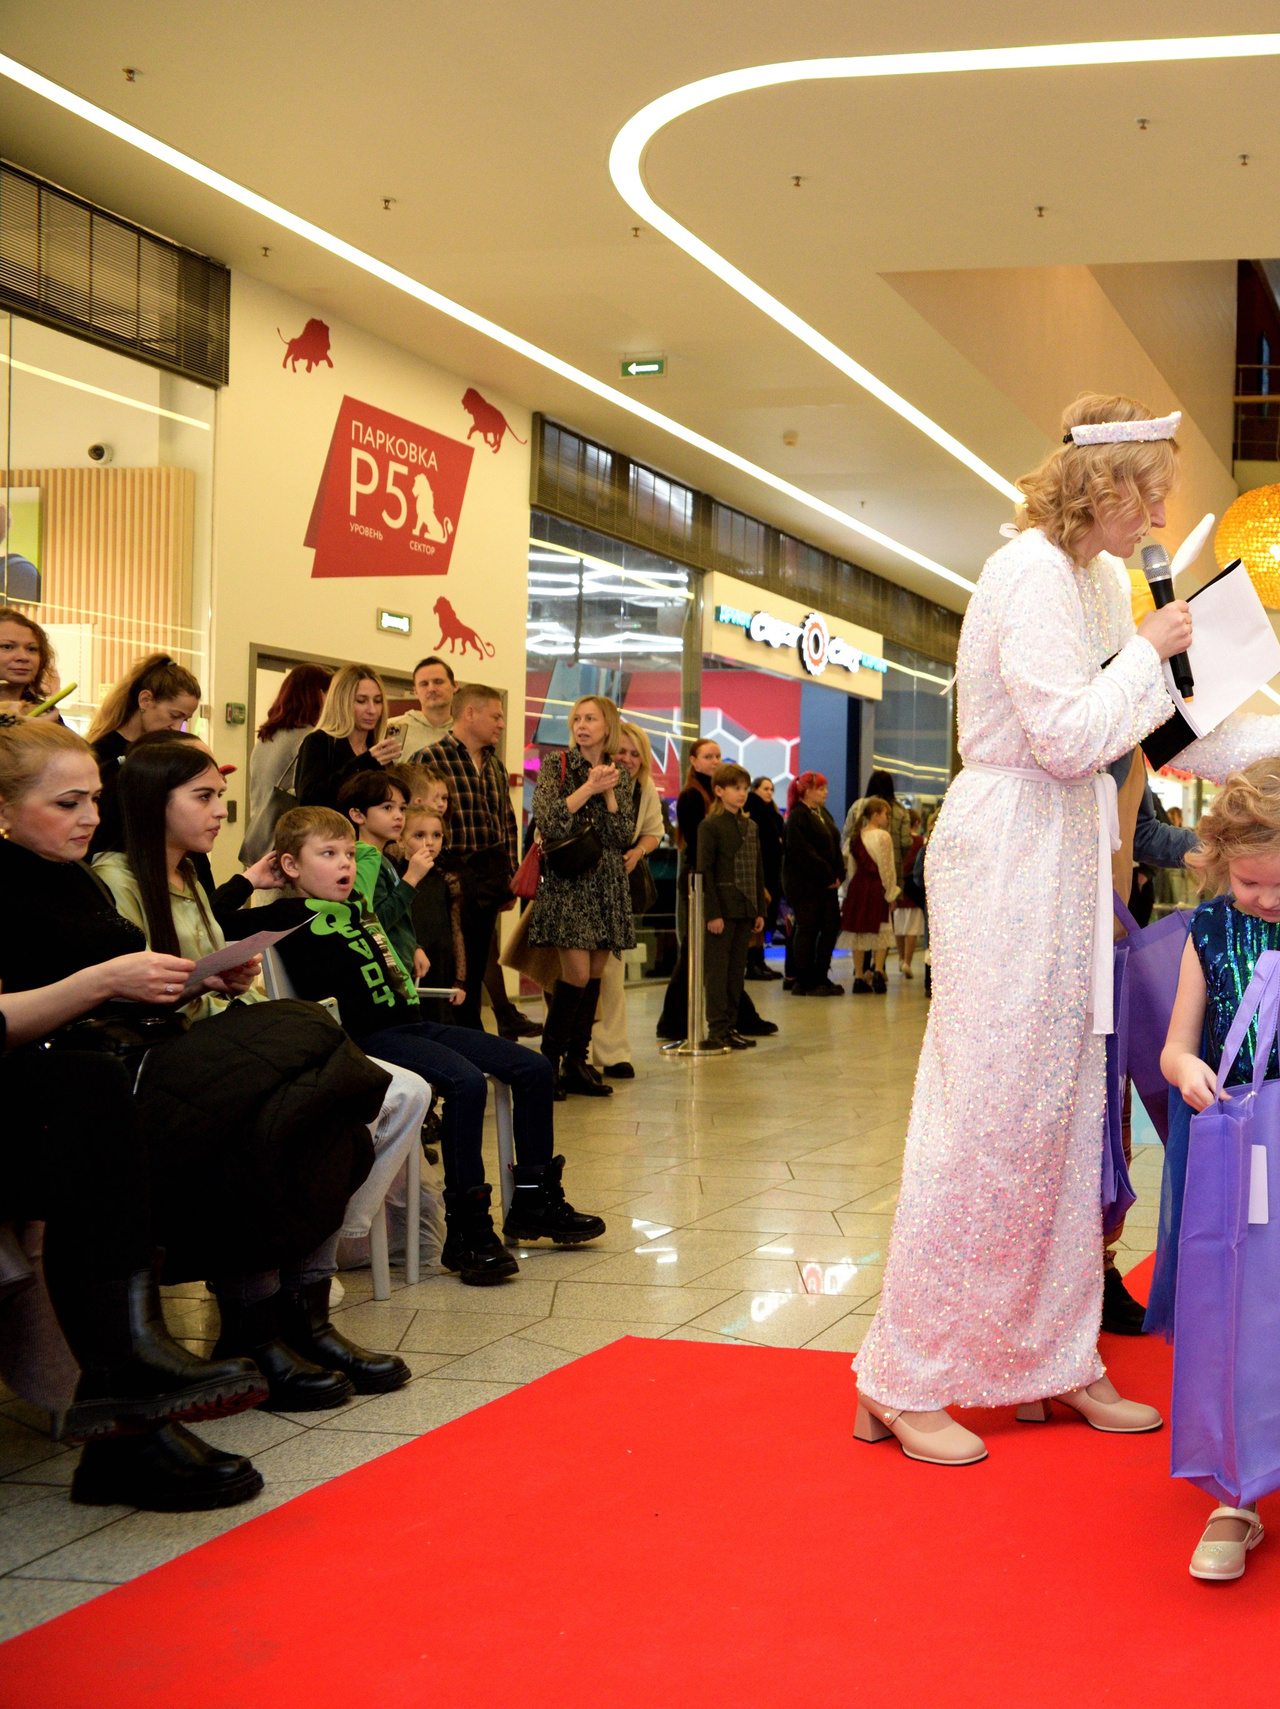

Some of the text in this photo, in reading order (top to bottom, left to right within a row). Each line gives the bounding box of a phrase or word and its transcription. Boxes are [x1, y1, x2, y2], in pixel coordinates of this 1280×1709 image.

[351, 420, 438, 472] ПАРКОВКА
[349, 521, 384, 541] УРОВЕНЬ
[409, 540, 436, 555] СЕКТОР
